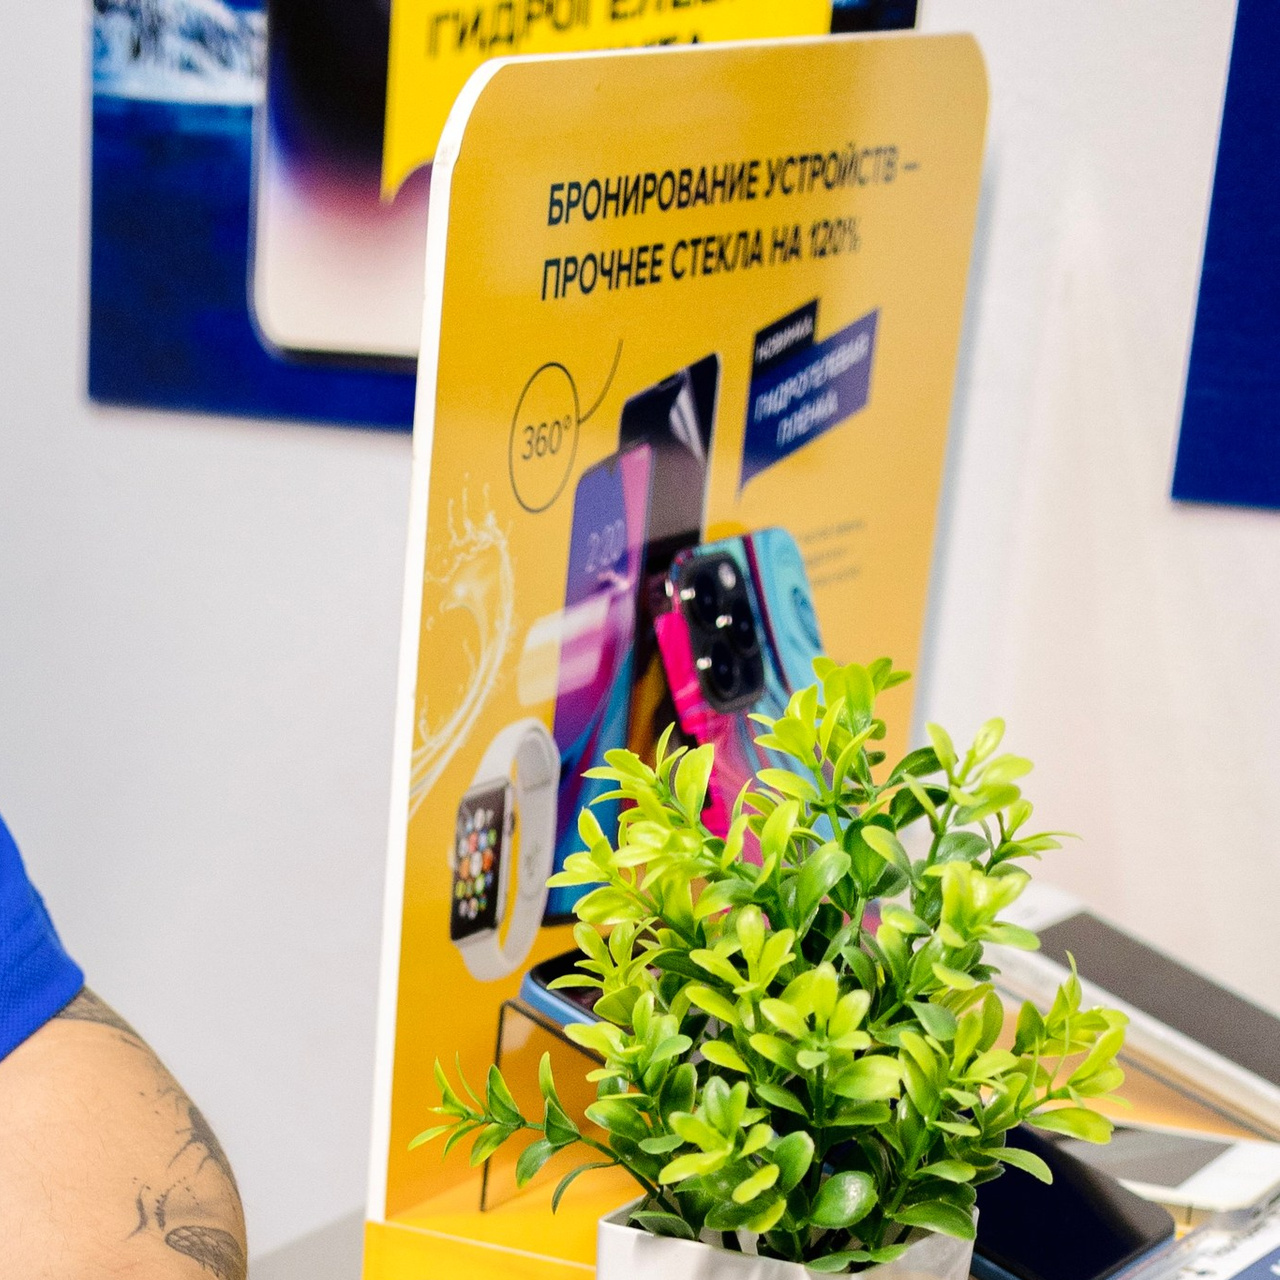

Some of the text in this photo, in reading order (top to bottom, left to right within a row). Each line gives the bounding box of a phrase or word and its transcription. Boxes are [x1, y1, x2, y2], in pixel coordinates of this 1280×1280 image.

[547, 159, 760, 227] БРОНИРОВАНИЕ
[764, 142, 900, 199] УСТРОЙСТВ
[541, 215, 863, 302] ПРОЧНЕЕ СТЕКЛА НА 120%
